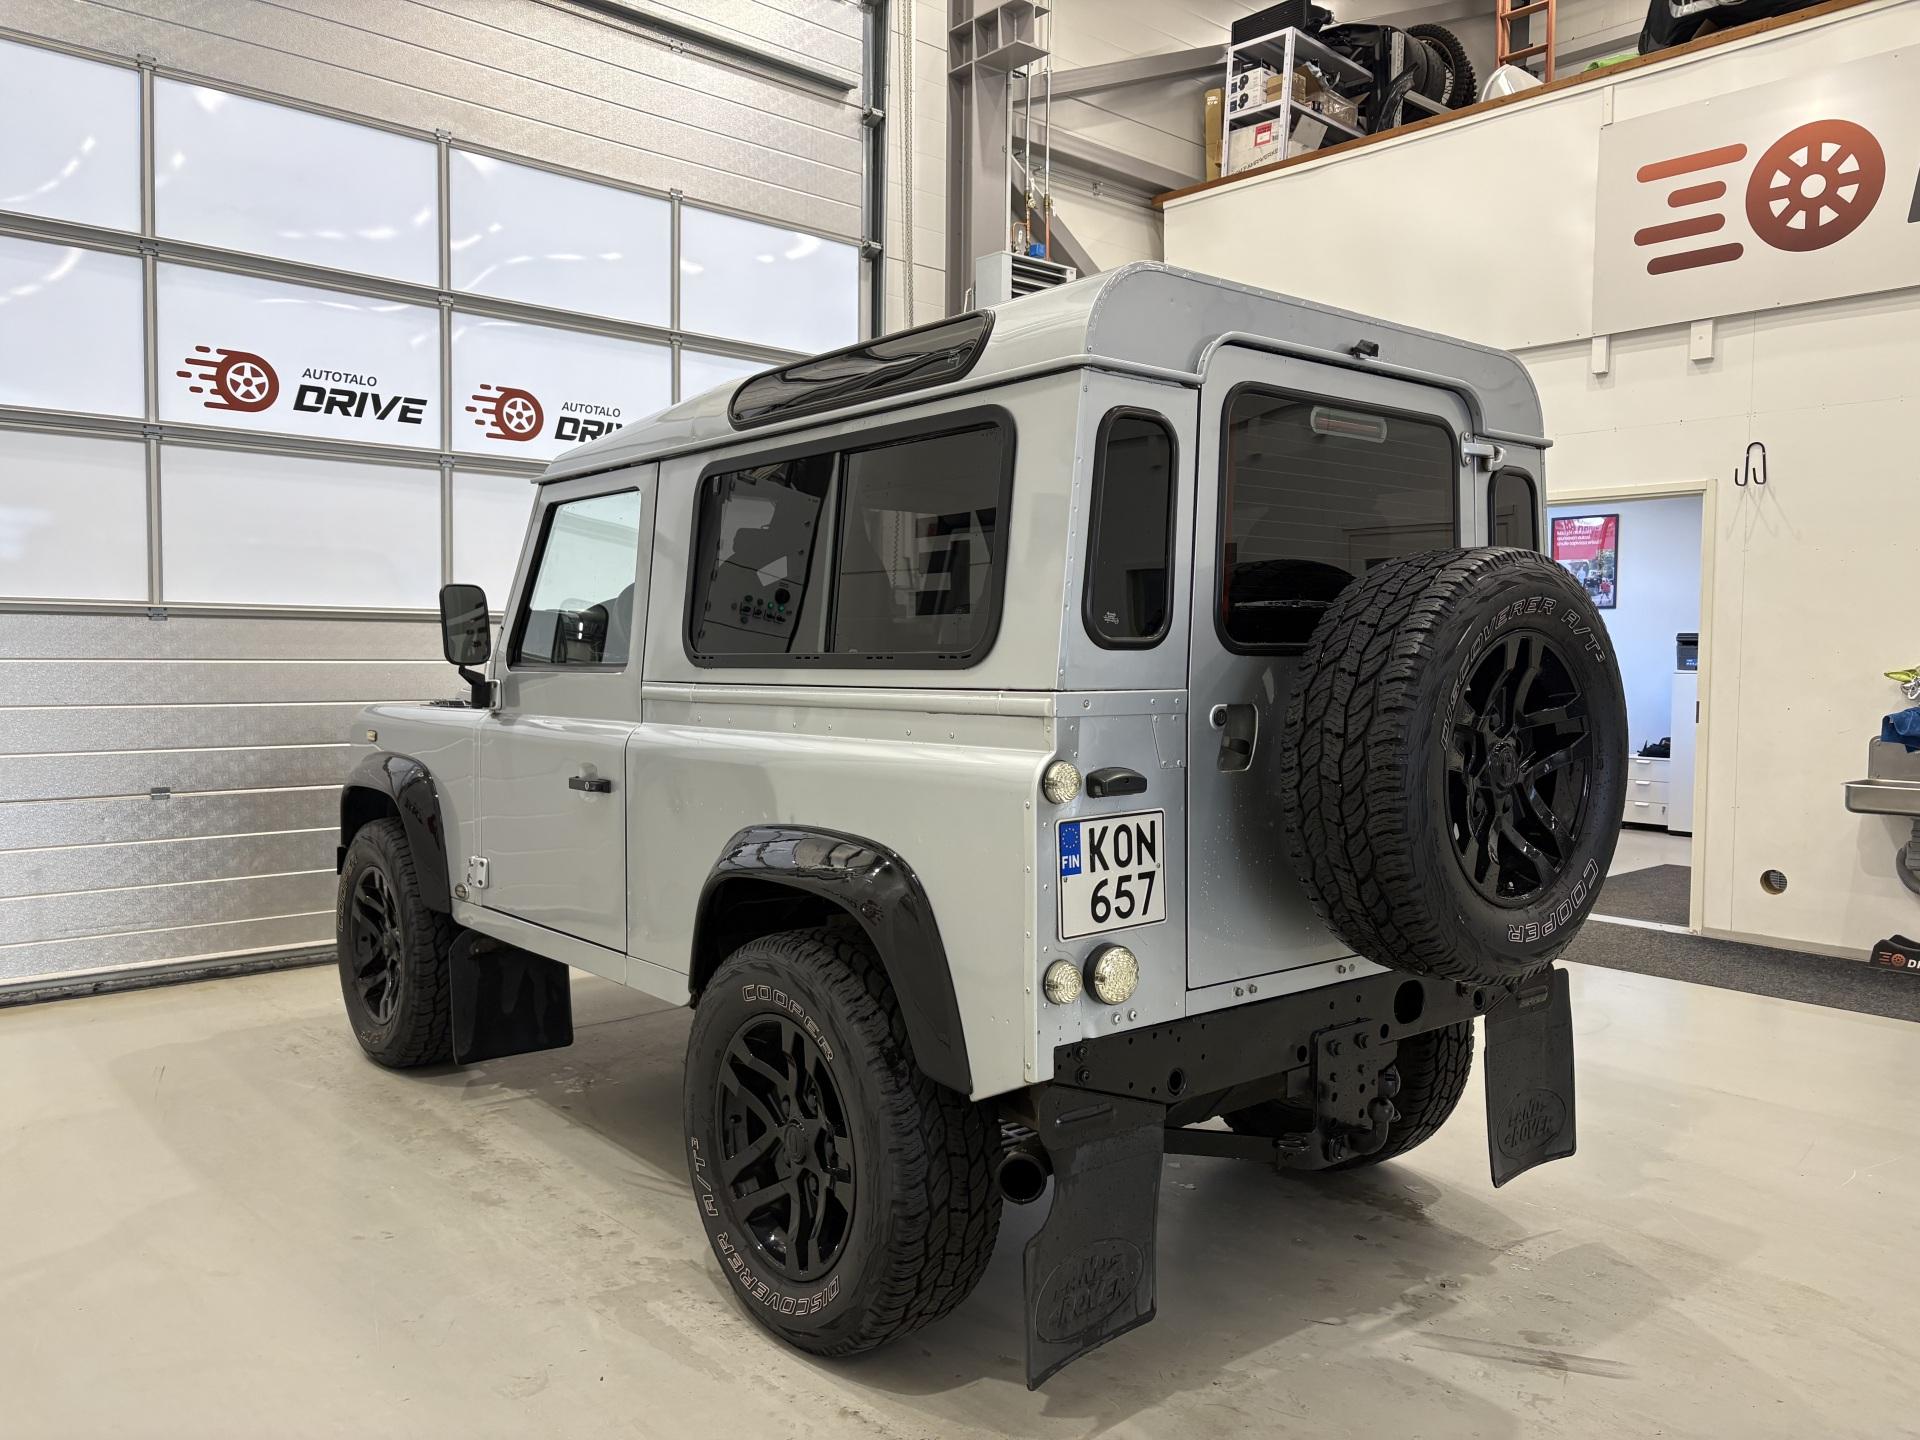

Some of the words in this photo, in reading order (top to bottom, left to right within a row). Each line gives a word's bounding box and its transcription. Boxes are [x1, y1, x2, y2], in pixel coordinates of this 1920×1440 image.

[302, 368, 377, 387] AUTOTALO
[293, 384, 428, 424] DRIVE
[561, 401, 621, 418] AUTOTALO
[554, 416, 623, 442] DRI
[1062, 854, 1080, 870] FIN
[1089, 820, 1156, 873] KON
[1091, 871, 1156, 924] 657
[1508, 858, 1599, 943] COOPER
[742, 984, 834, 1063] COOPER
[717, 1232, 840, 1316] DISCOVERER
